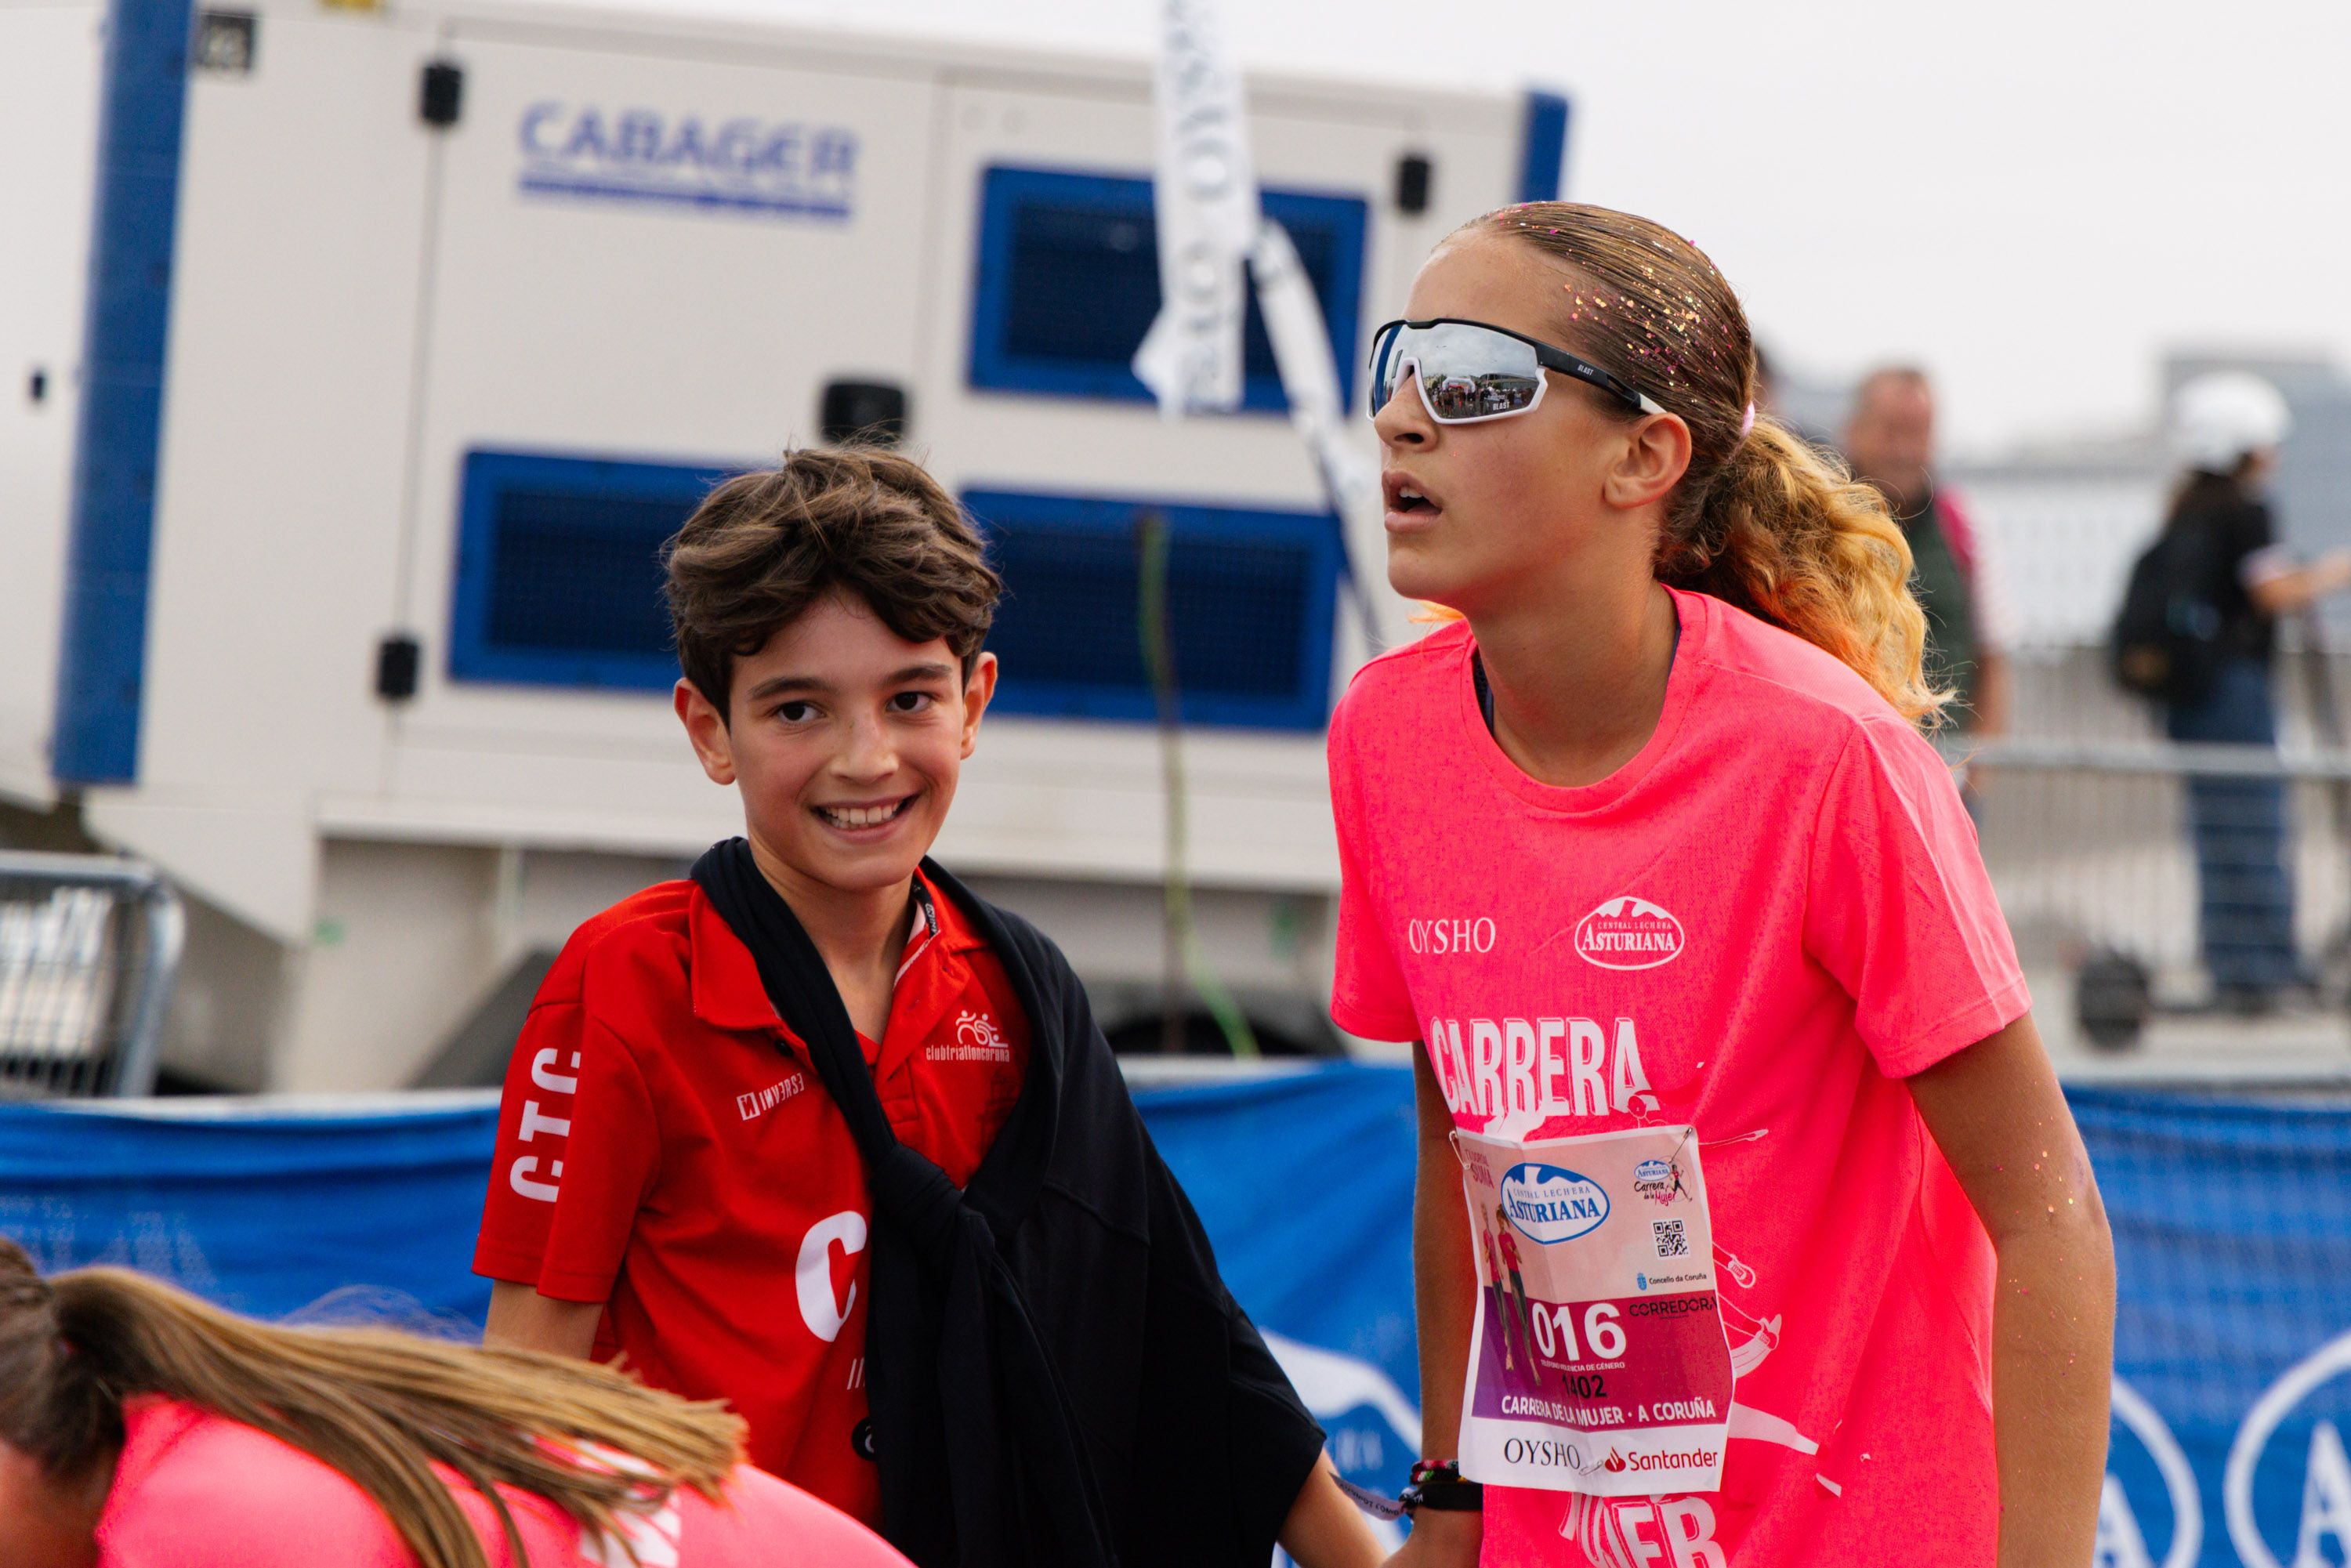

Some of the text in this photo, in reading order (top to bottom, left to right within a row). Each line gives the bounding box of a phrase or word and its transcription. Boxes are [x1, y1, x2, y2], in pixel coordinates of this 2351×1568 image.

[1577, 364, 1593, 376] BLAST
[1493, 401, 1509, 411] BLAST
[1409, 917, 1496, 954] OYSHO
[1581, 923, 1675, 951] ASTURIANA
[1429, 1016, 1660, 1117] CARRERA
[509, 1048, 581, 1202] CTC
[1638, 1168, 1668, 1178] ASTURIANA
[1513, 1186, 1590, 1199] CENTRAL LECHERA
[1634, 1181, 1665, 1193] Carrera
[1655, 1186, 1675, 1206] Mujer
[1507, 1188, 1601, 1222] ASTURIANA
[1649, 1276, 1675, 1284] Concello
[1532, 1302, 1627, 1361] 016
[1596, 1361, 1625, 1370] GÉNERO
[1563, 1374, 1607, 1399] 1402
[1502, 1396, 1715, 1427] CARRERA DE LA MUJER A CORUÑA
[1504, 1438, 1718, 1471] OYSHO Santander
